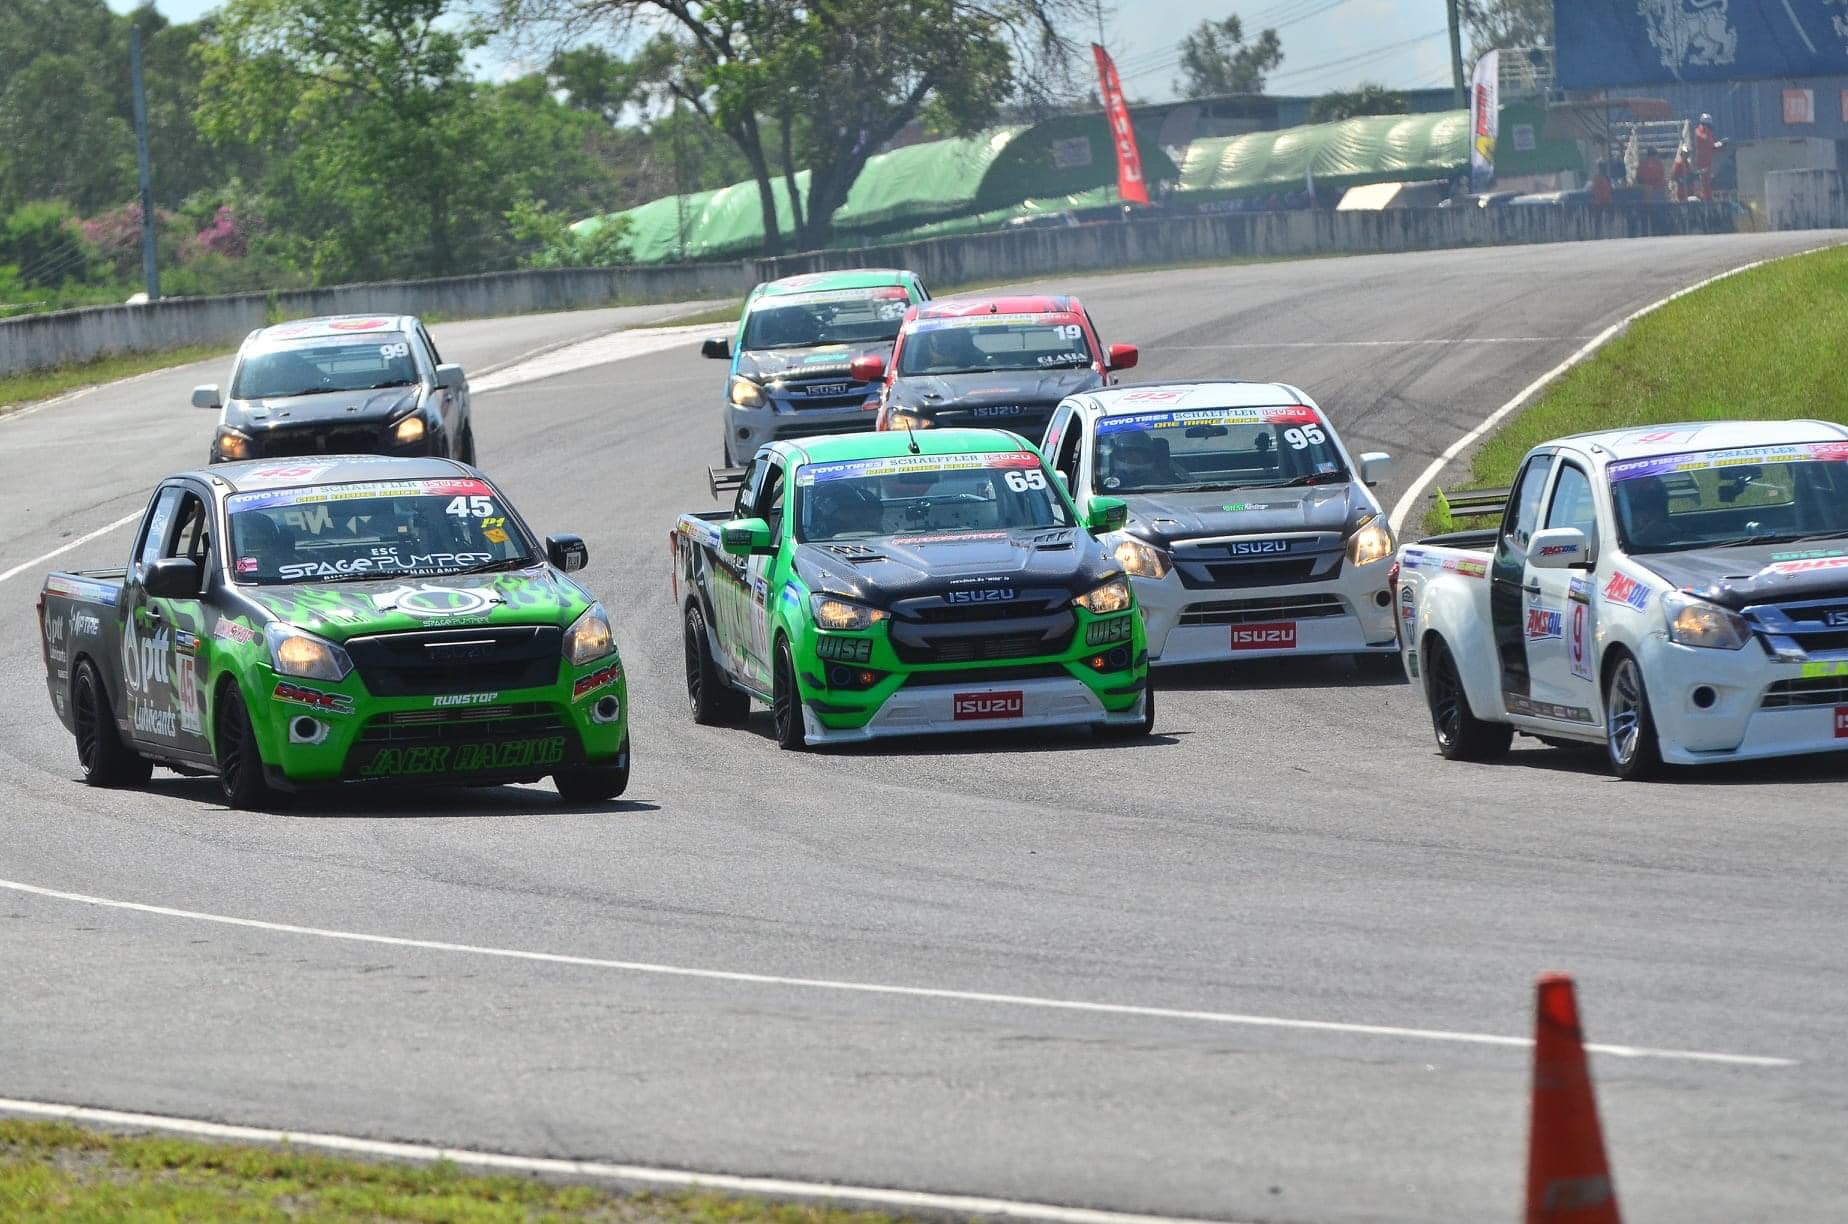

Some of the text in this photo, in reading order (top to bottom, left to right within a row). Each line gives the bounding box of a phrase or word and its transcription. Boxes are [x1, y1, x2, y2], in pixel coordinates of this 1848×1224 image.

[1053, 324, 1082, 341] 19
[973, 405, 1020, 417] ISUZU
[1103, 408, 1307, 427] TOYO TIRES SCHAEFFLER ISUZU
[1153, 420, 1180, 430] ONE
[1284, 423, 1326, 450] 95
[812, 463, 845, 475] TOYO
[889, 454, 979, 466] SCHAEFFLER
[1607, 460, 1648, 473] TOYO
[1004, 470, 1047, 492] 65
[446, 496, 494, 518] 45
[371, 547, 398, 556] ESC
[1232, 540, 1287, 554] ISUZU
[1540, 544, 1577, 557] AMSOIL
[949, 588, 1014, 604] ISUZU
[1604, 571, 1651, 610] AMSOIL
[1087, 617, 1131, 646] WISE
[1527, 608, 1562, 638] AMSOIL
[1573, 604, 1583, 662] 9
[1234, 628, 1294, 643] ISUZU
[816, 636, 872, 662] WISE
[141, 626, 169, 693] ptt
[181, 658, 194, 714] 45
[432, 692, 498, 707] RUNSTOP
[957, 699, 1021, 714] ISUZU
[361, 736, 567, 775] JACK RACING
